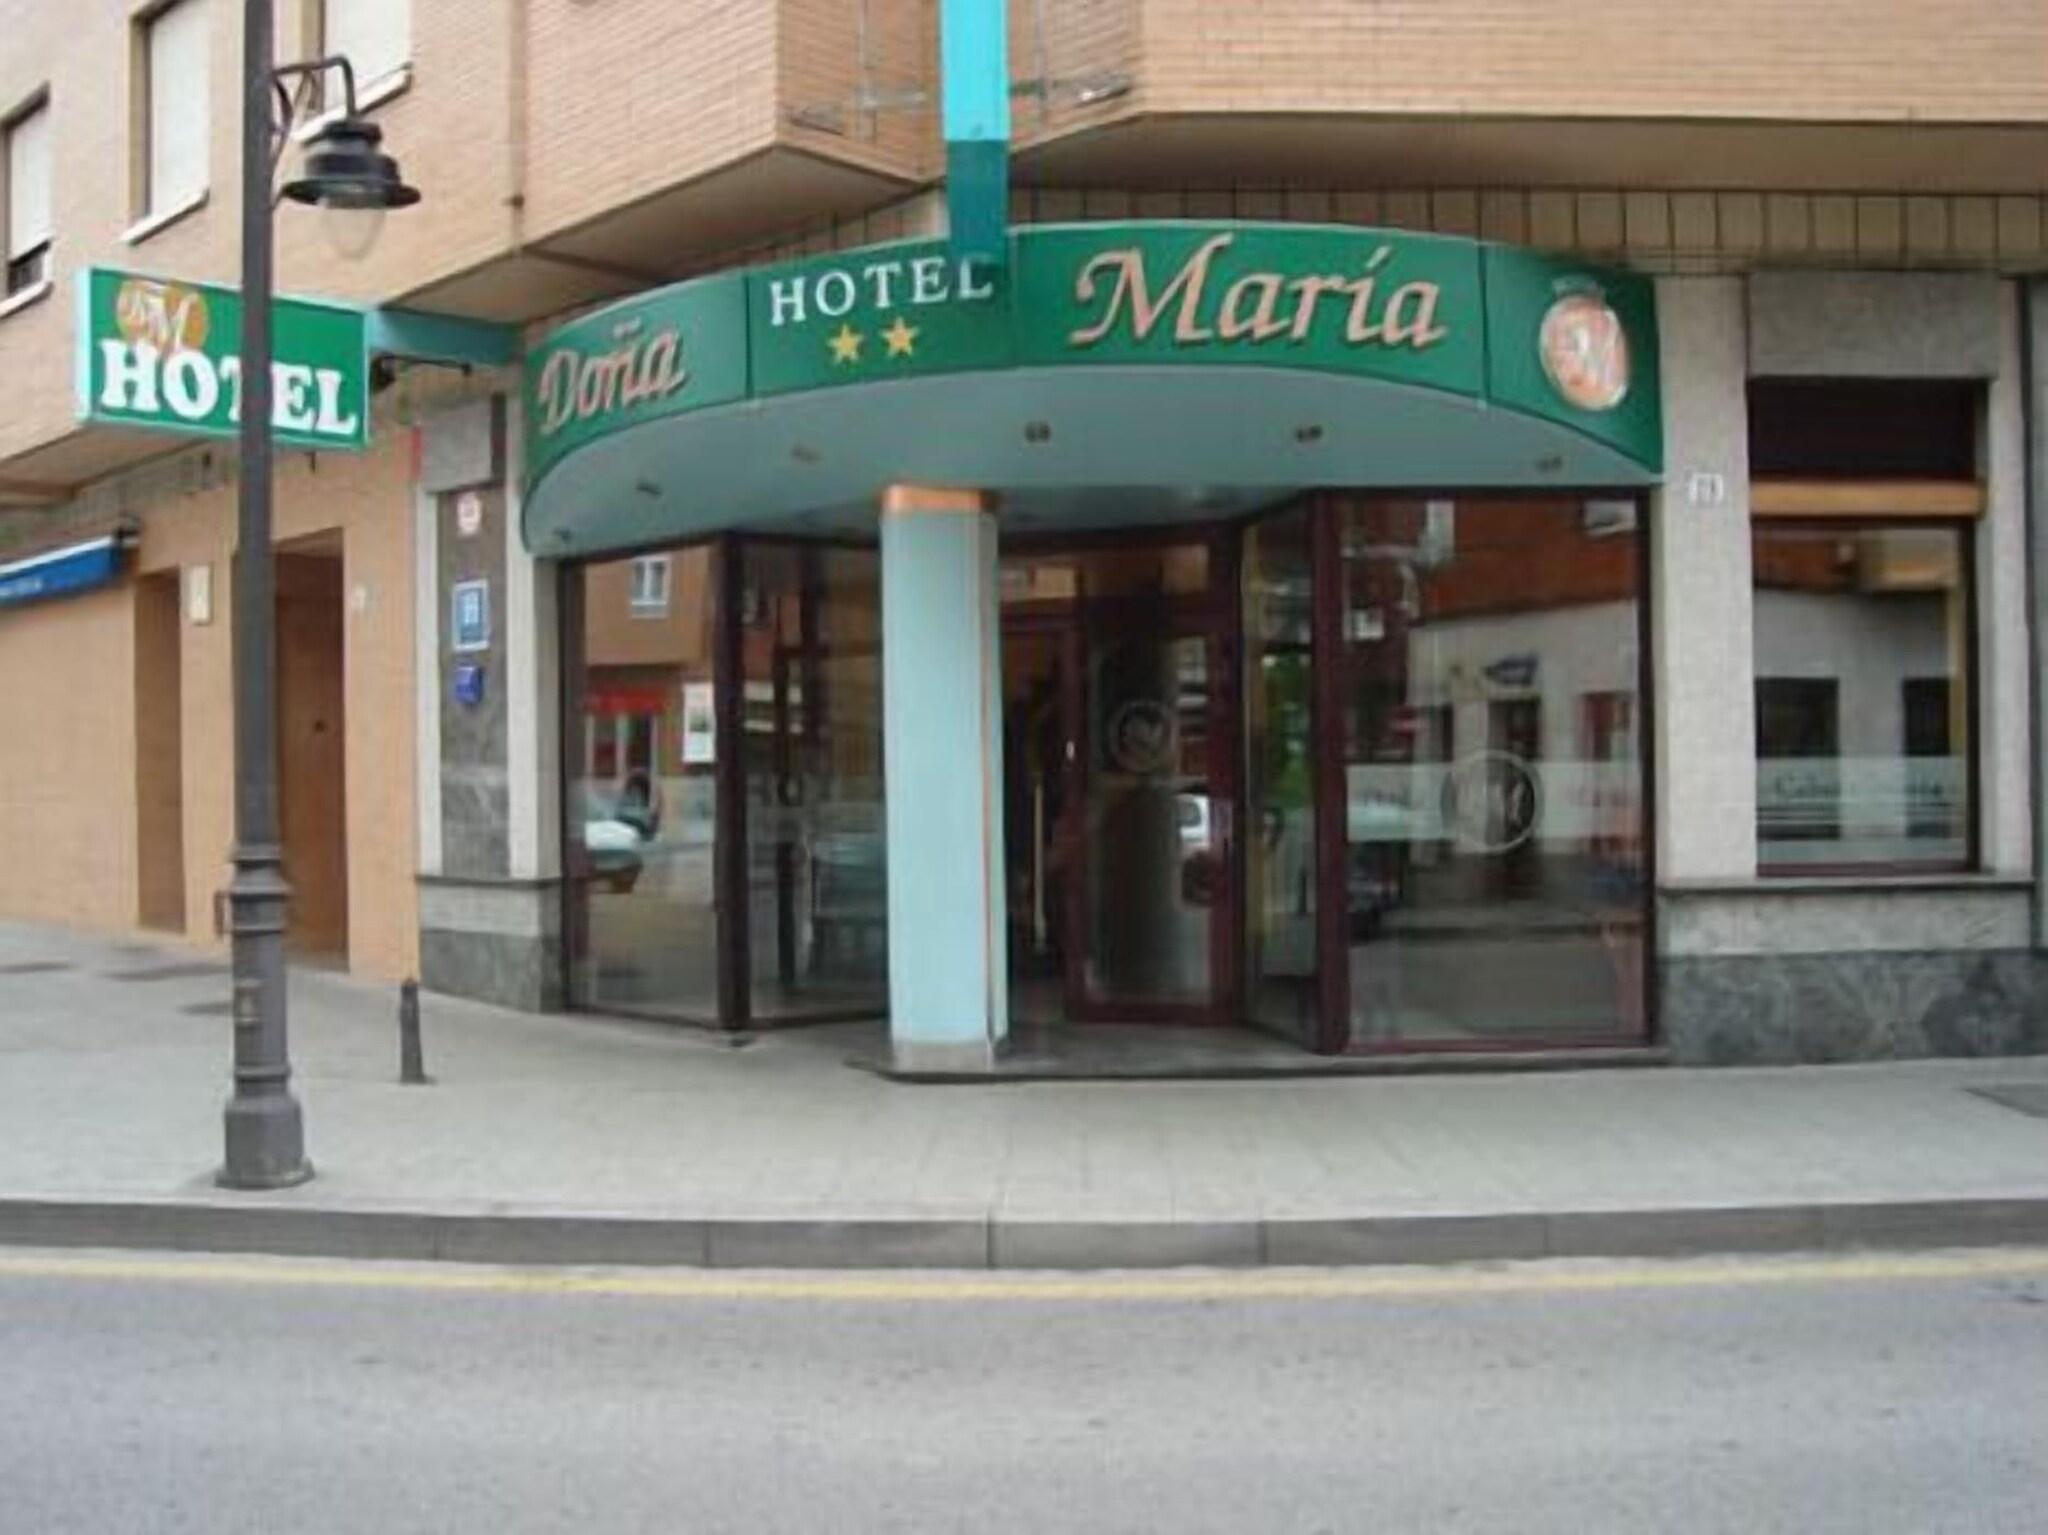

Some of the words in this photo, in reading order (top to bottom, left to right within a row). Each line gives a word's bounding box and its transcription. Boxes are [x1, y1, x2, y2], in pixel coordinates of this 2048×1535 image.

[769, 256, 994, 326] HOTEL
[1069, 231, 1448, 346] María
[538, 316, 688, 436] Doña
